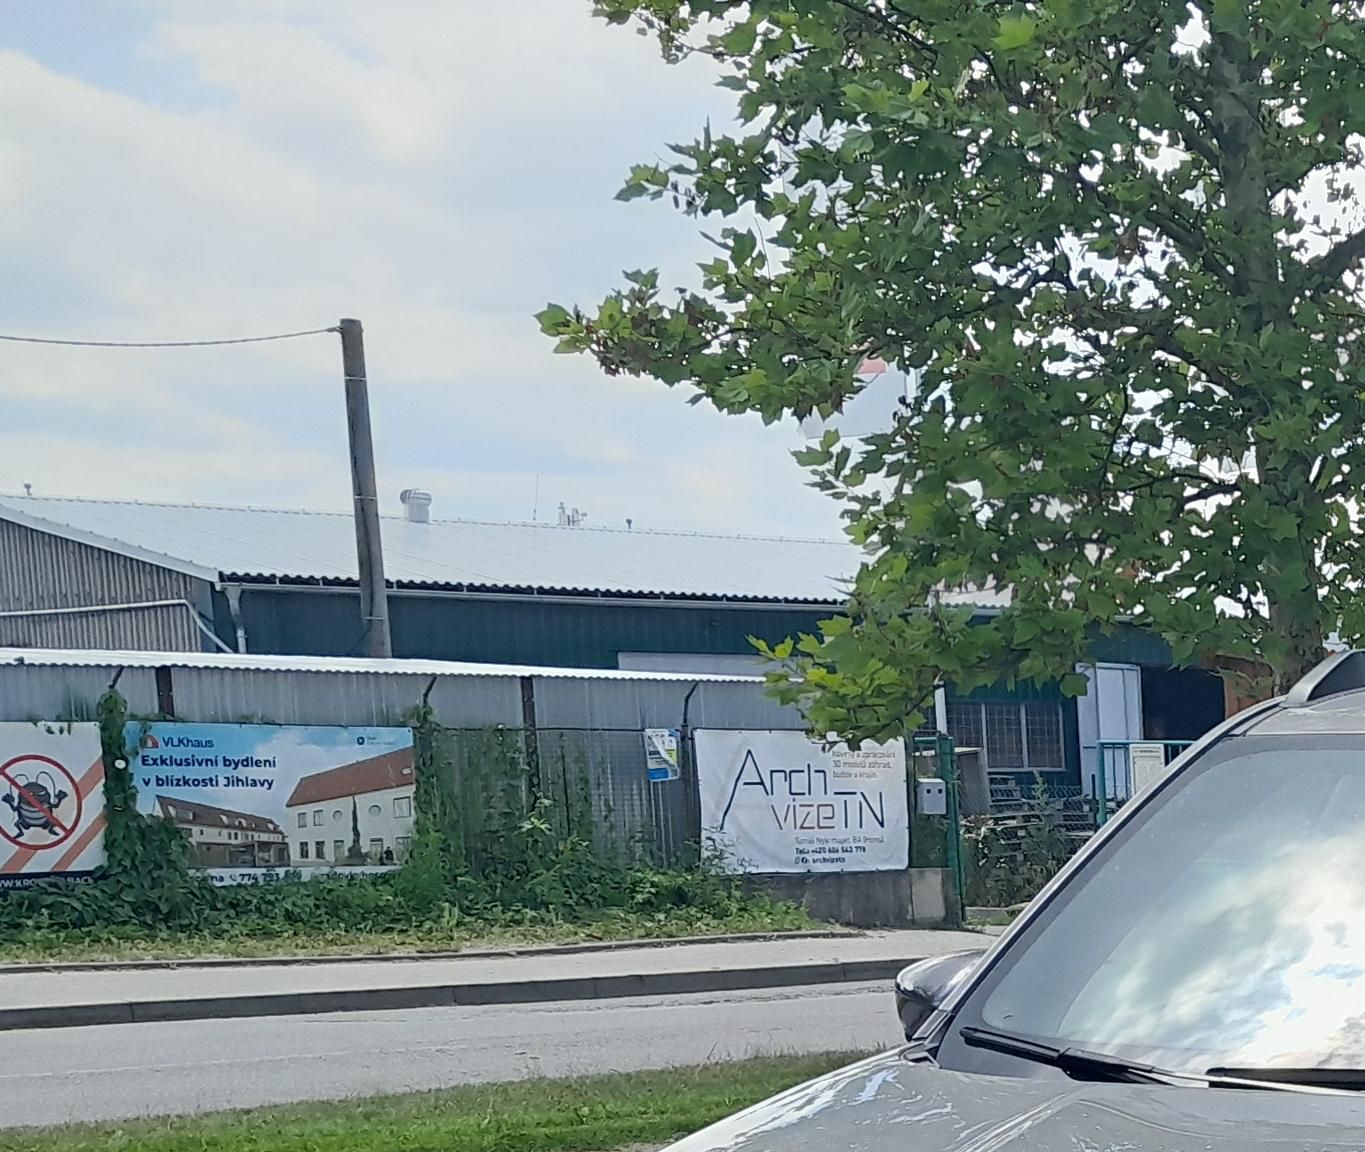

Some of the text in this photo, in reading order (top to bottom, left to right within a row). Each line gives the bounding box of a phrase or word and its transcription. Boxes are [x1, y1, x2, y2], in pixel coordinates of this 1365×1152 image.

[162, 736, 215, 748] VLKhaus
[141, 754, 277, 770] Exklusivní bydlení
[142, 774, 274, 790] v blízkosti Jihlavy
[720, 749, 828, 830] Arch
